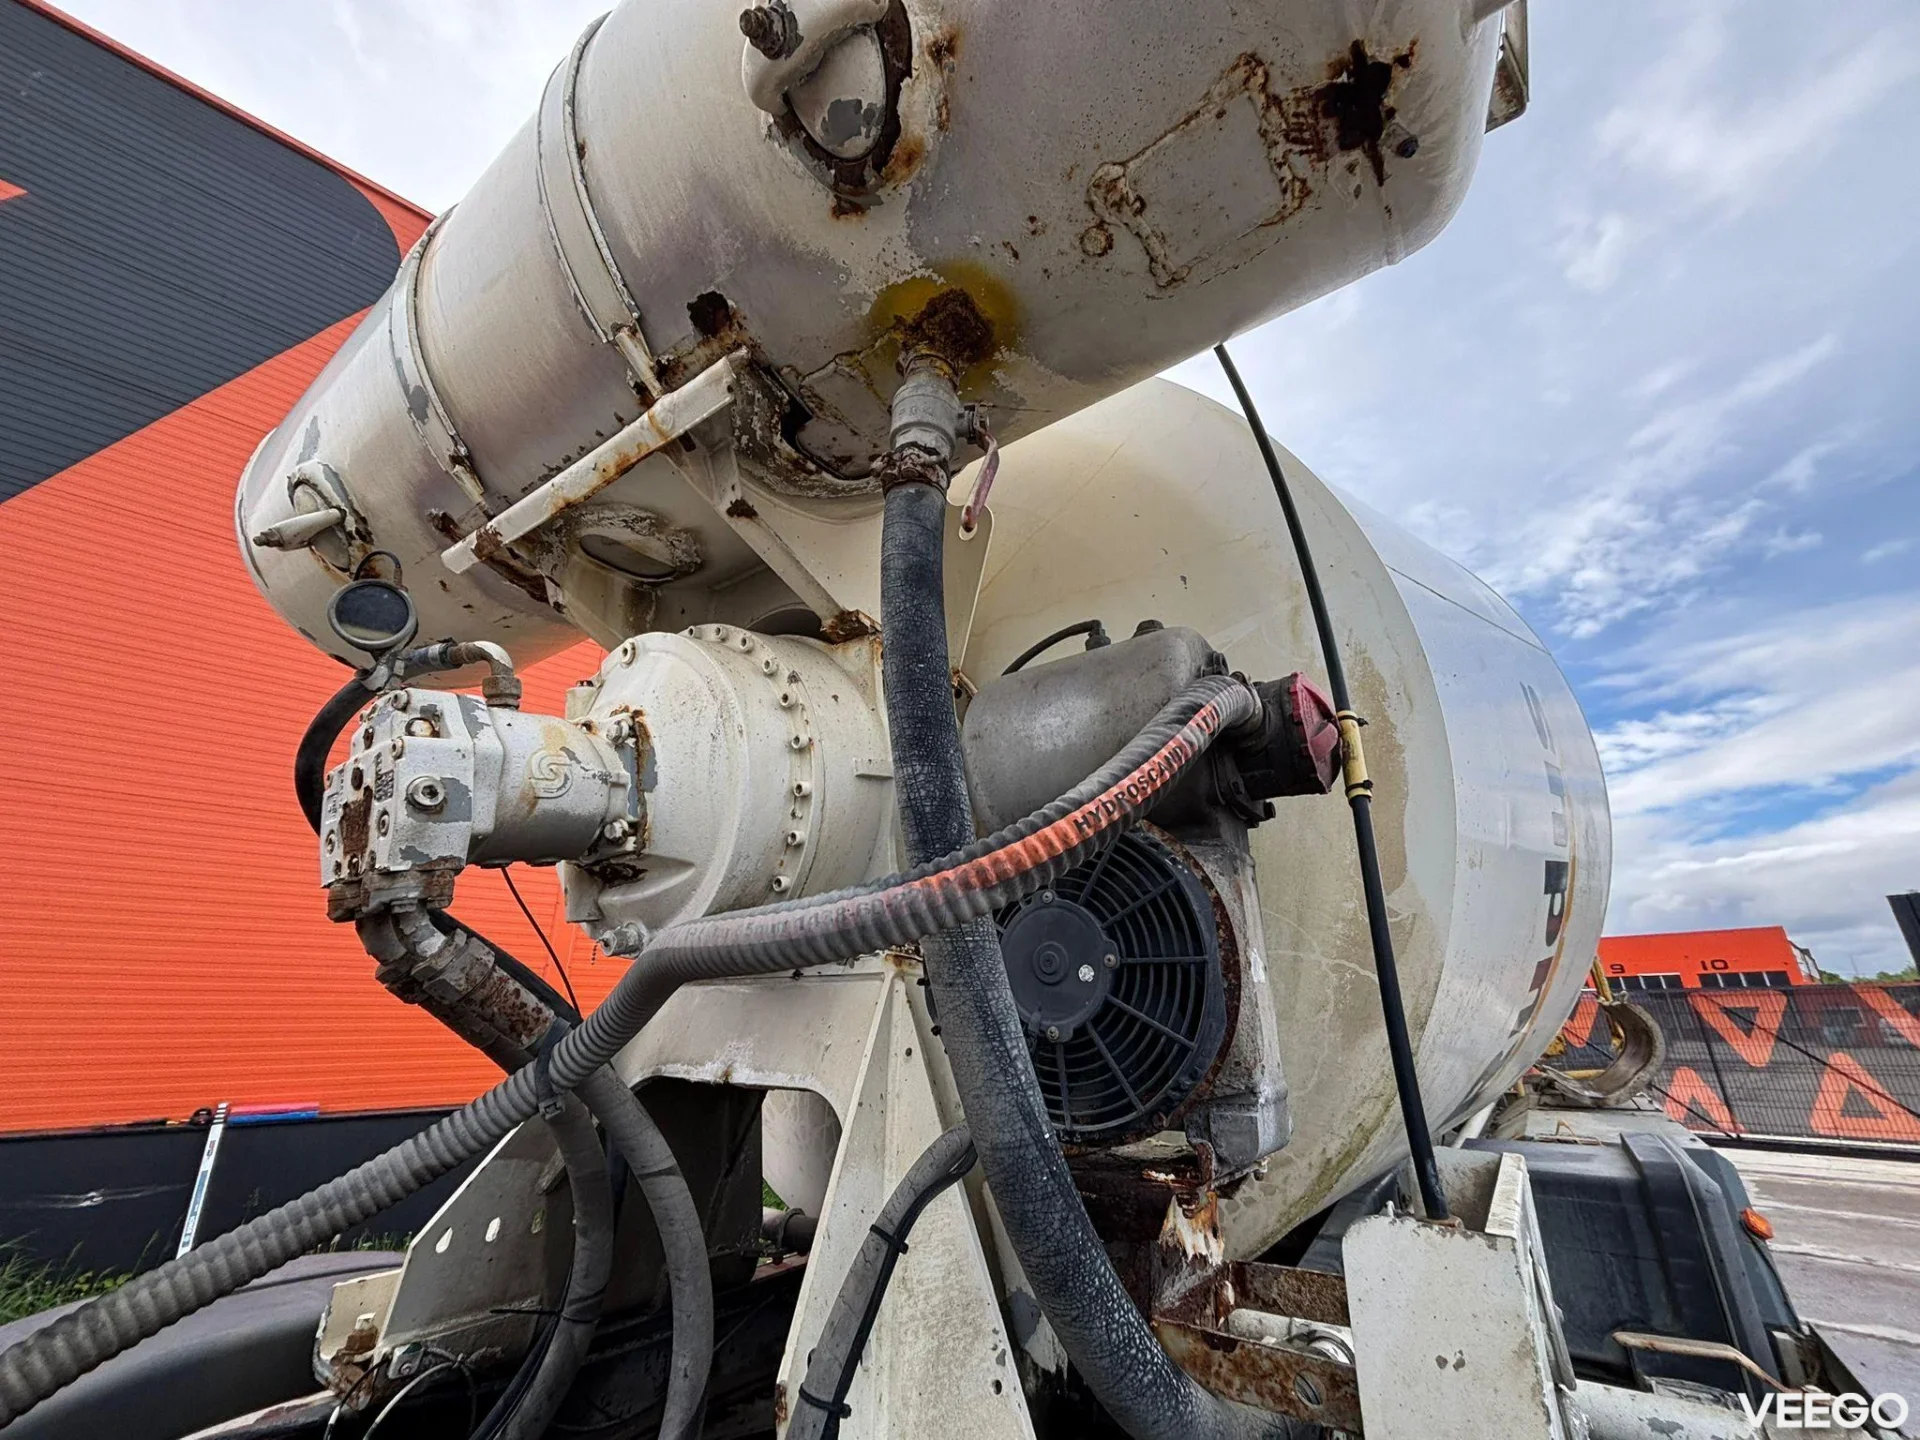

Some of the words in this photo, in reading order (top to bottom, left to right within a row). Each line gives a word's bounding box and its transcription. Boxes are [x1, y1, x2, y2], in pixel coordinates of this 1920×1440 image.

[1073, 745, 1185, 834] HYDROSCAND
[1609, 963, 1626, 975] 9
[1700, 959, 1729, 971] 10
